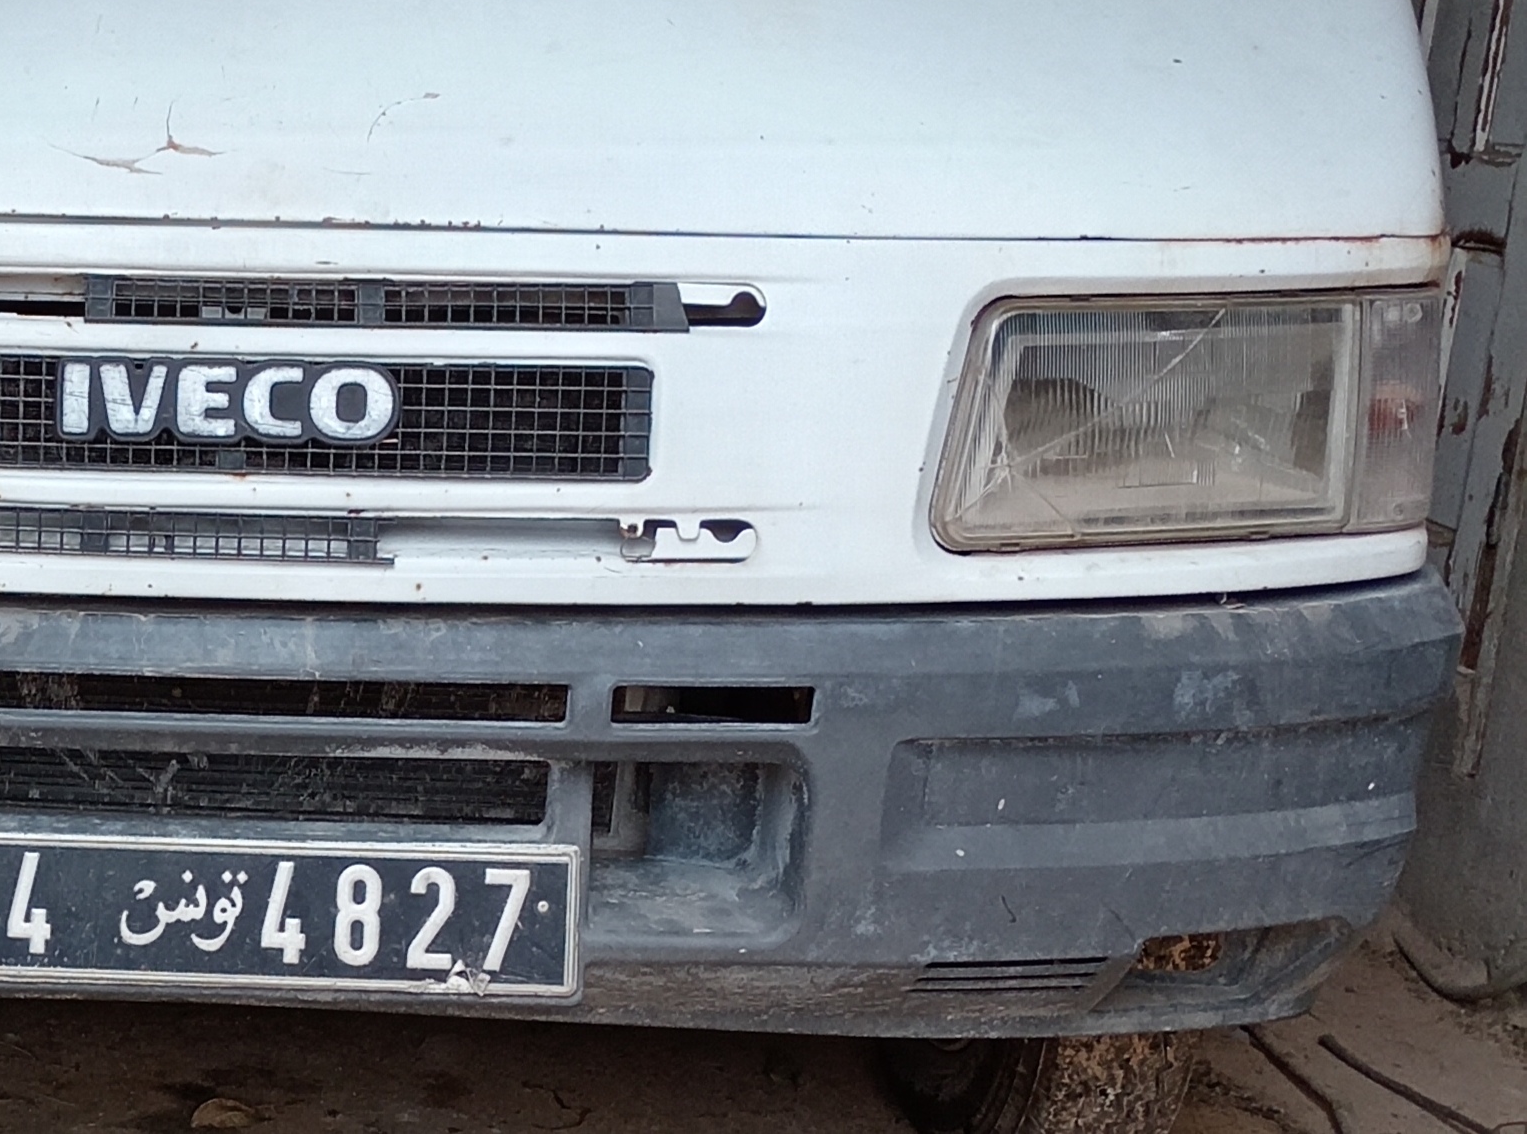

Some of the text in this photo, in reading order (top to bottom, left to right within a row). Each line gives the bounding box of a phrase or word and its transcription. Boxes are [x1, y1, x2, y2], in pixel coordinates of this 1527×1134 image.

[61, 362, 395, 440] IVECO
[119, 868, 248, 953] تونس
[260, 860, 533, 973] 4827
